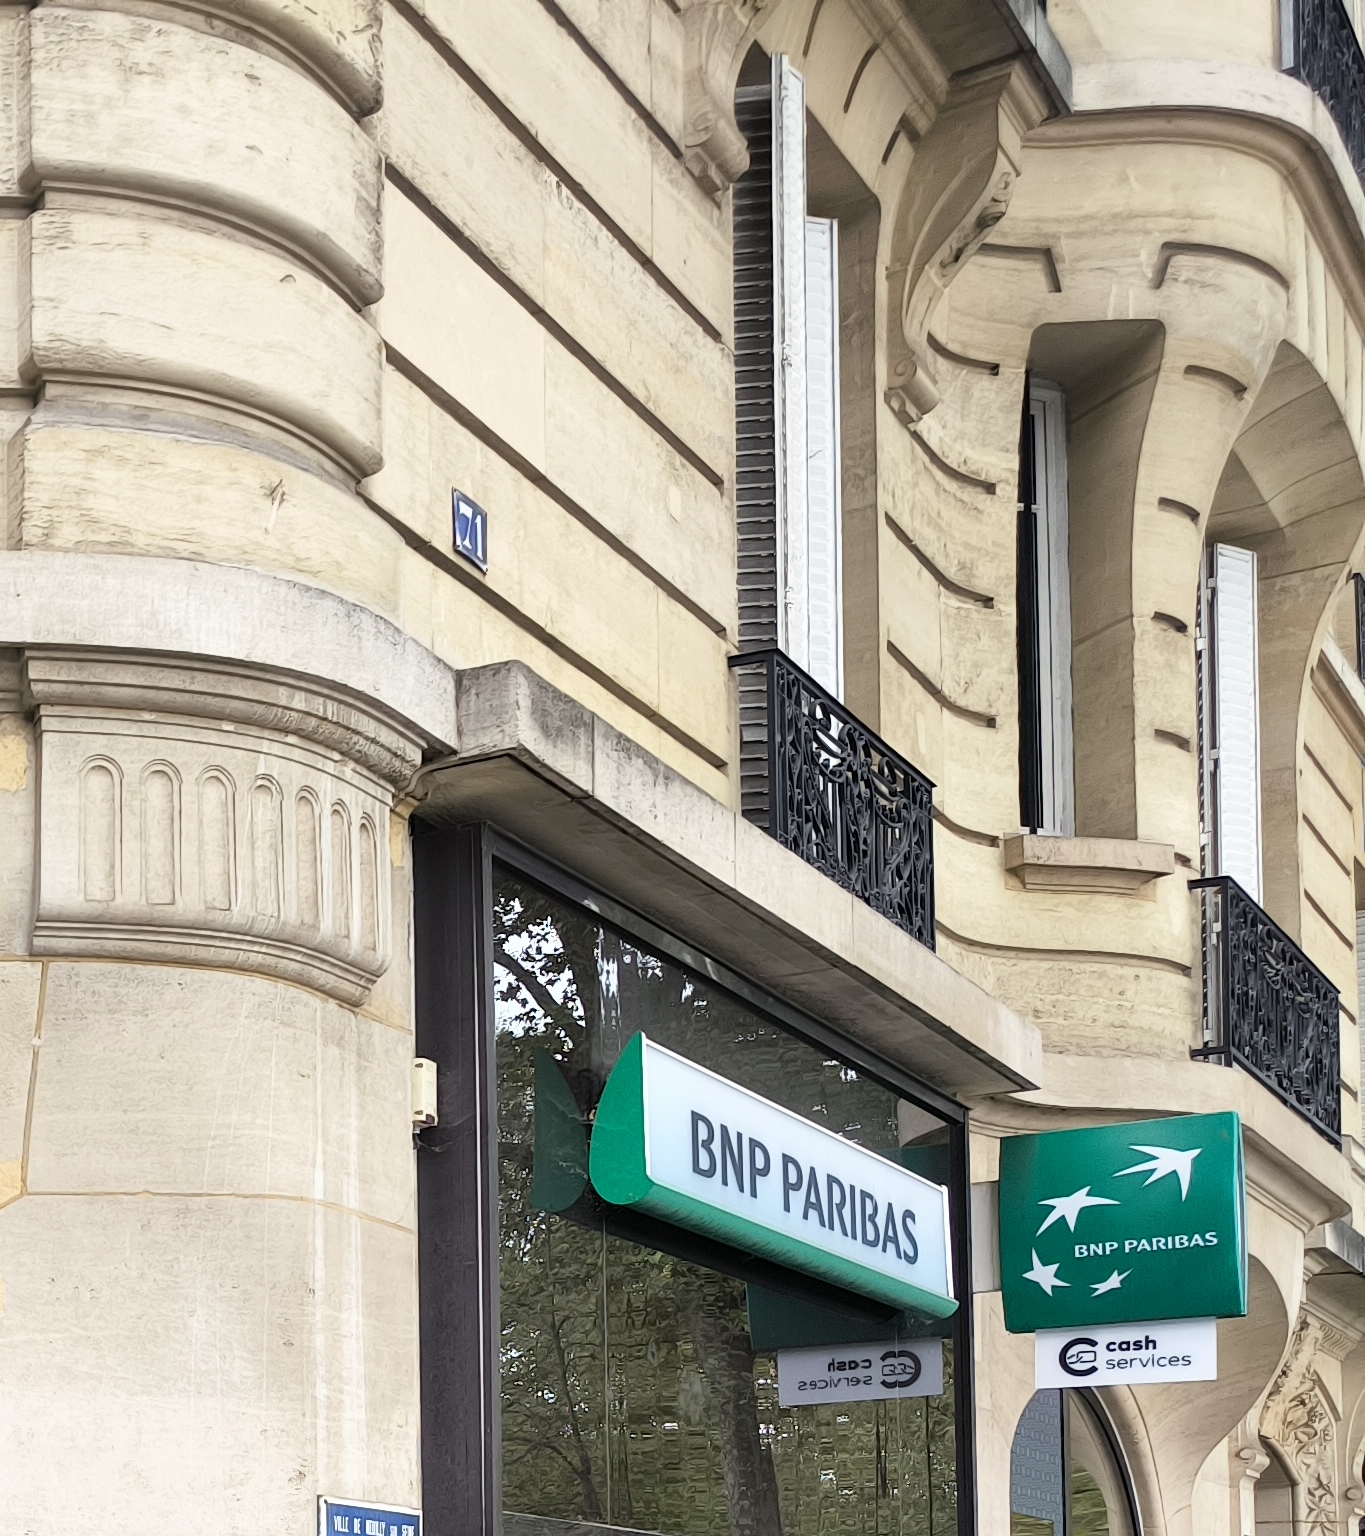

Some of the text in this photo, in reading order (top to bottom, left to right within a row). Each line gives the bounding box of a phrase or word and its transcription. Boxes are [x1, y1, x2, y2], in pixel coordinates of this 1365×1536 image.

[458, 500, 483, 560] 71
[691, 1110, 919, 1265] BNP PARIBAS
[1074, 1231, 1218, 1258] BNP PARIBAS
[1105, 1335, 1157, 1352] cash
[1105, 1353, 1192, 1370] services
[333, 1514, 349, 1533] VILLE
[353, 1517, 361, 1535] DE
